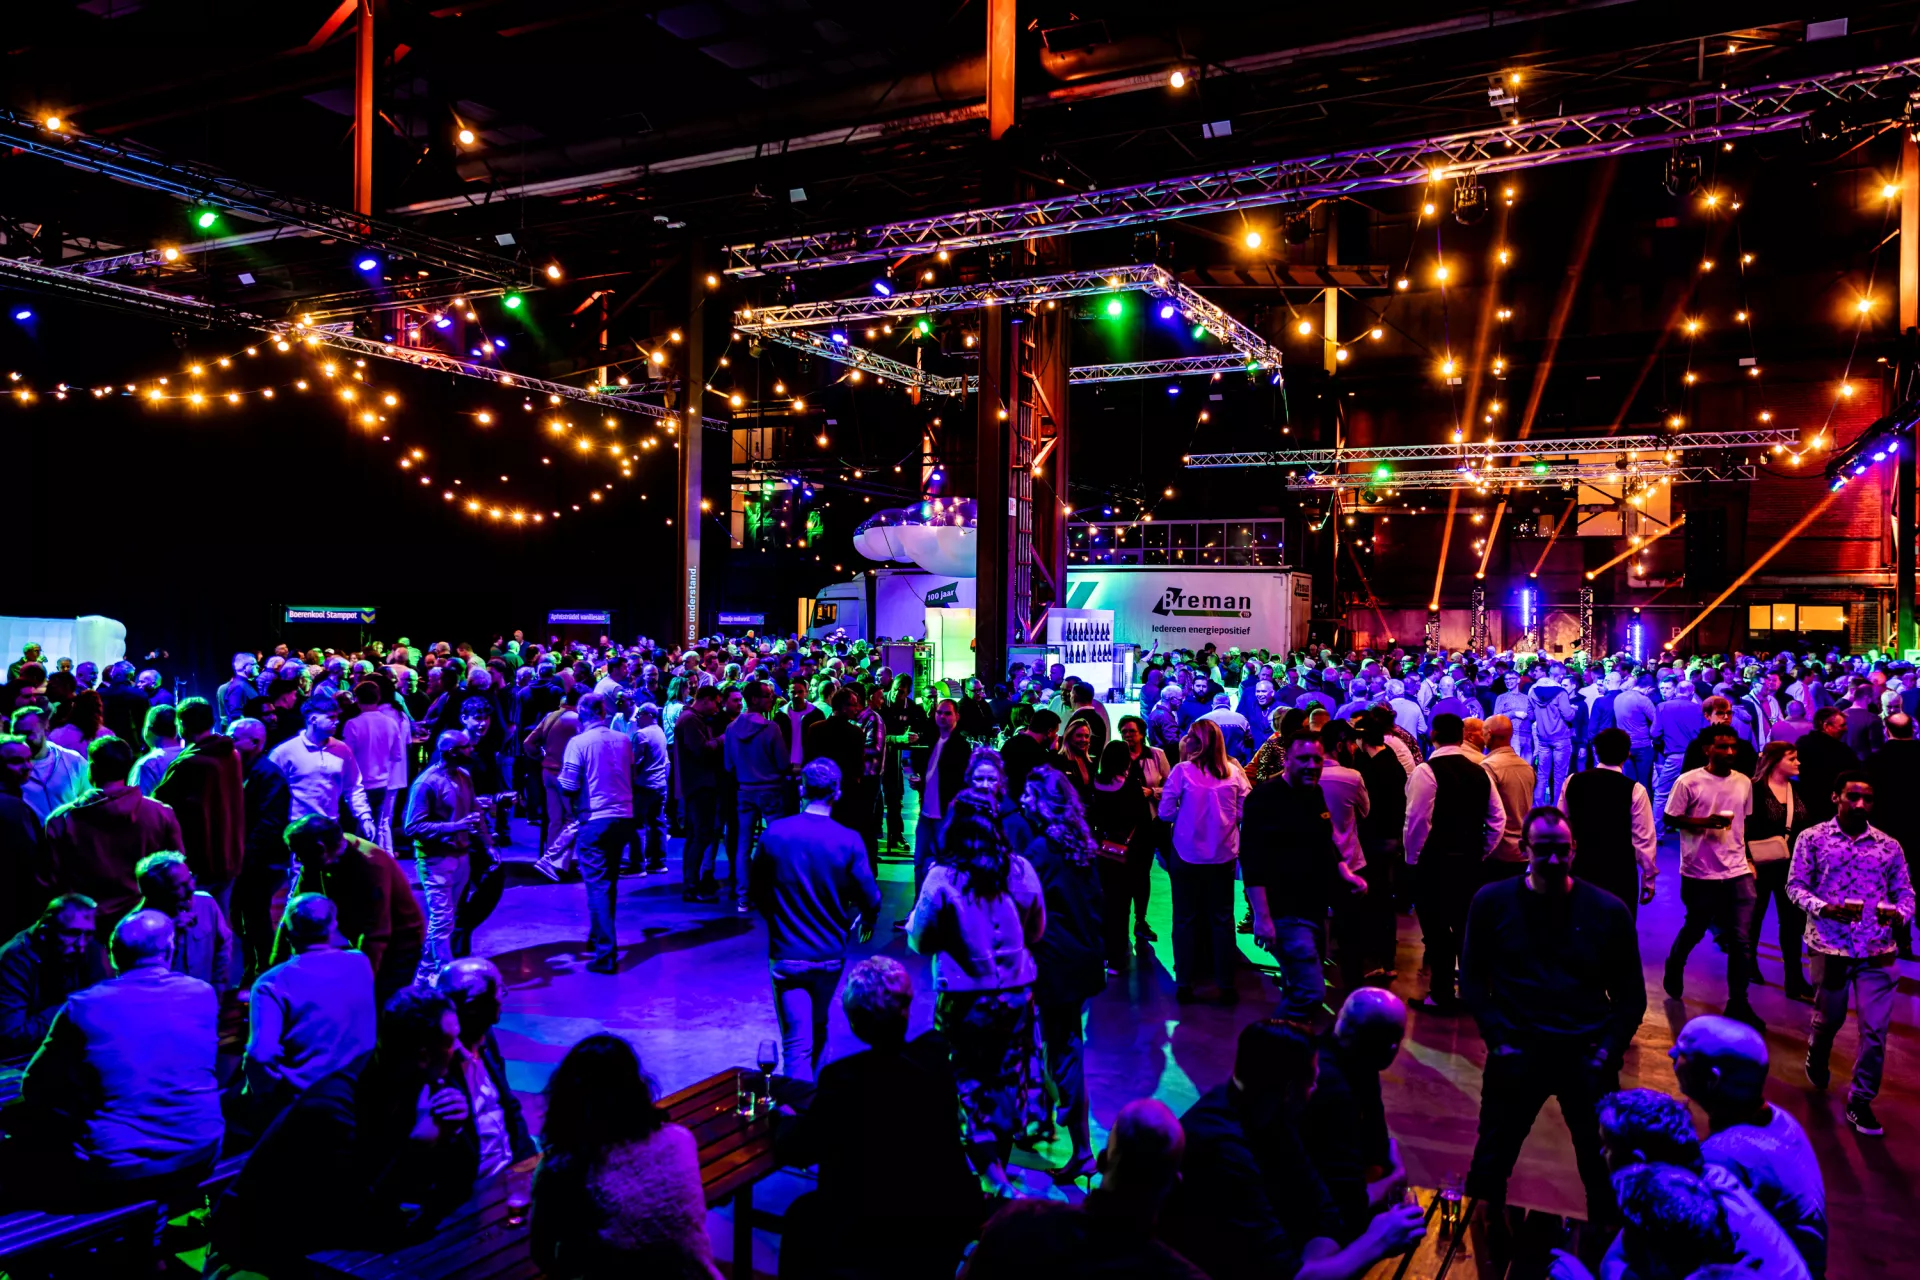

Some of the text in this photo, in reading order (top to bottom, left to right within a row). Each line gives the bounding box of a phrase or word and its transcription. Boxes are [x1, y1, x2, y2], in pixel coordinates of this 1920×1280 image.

[687, 565, 697, 622] understand.
[927, 590, 955, 601] 100 jaar
[1162, 590, 1251, 610] Breman
[289, 611, 358, 620] Boerenkool Stamppot
[688, 624, 696, 641] too
[1152, 624, 1251, 636] Iedereen energiepositief
